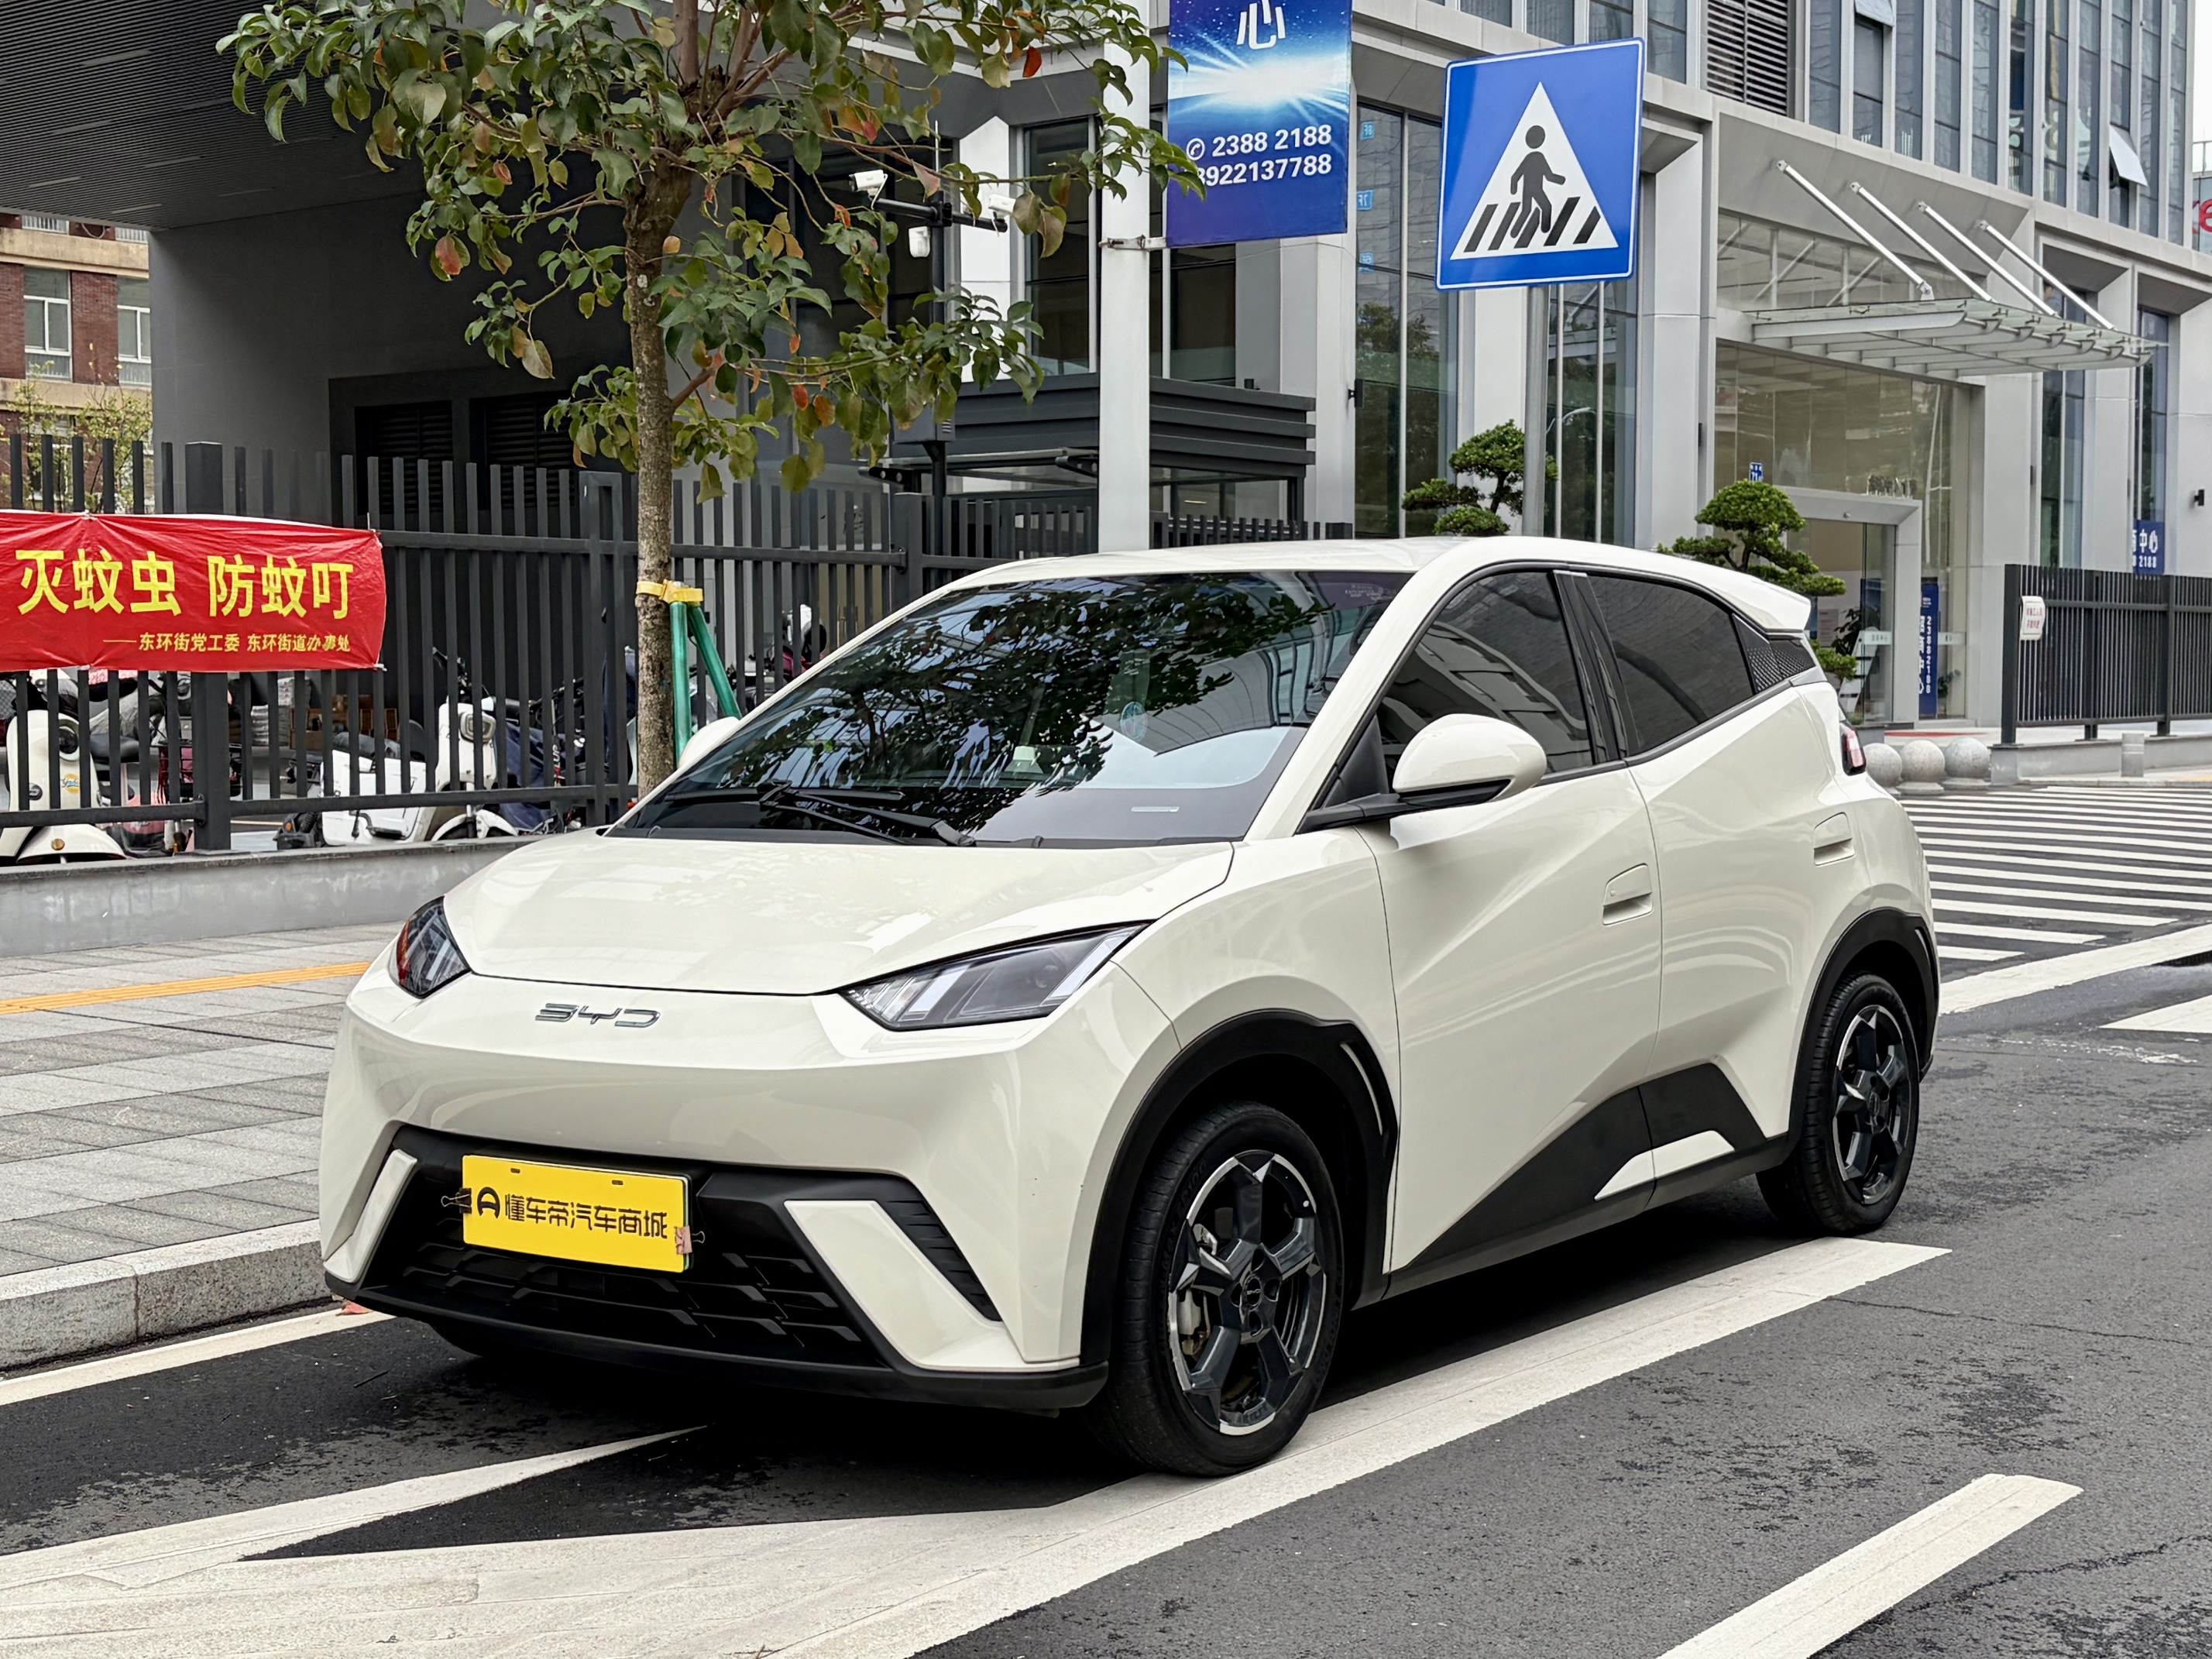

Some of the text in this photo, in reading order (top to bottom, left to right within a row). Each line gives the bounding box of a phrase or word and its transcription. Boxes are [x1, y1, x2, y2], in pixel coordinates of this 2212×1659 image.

[1212, 124, 1332, 157] 2388 2188
[2139, 555, 2157, 568] 2188
[15, 548, 354, 619] 灭蚊虫 防蚊叮
[247, 634, 351, 653] 东环街道办事处
[535, 1003, 661, 1029] BYD
[505, 1193, 668, 1239] 懂车帝汽车商城
